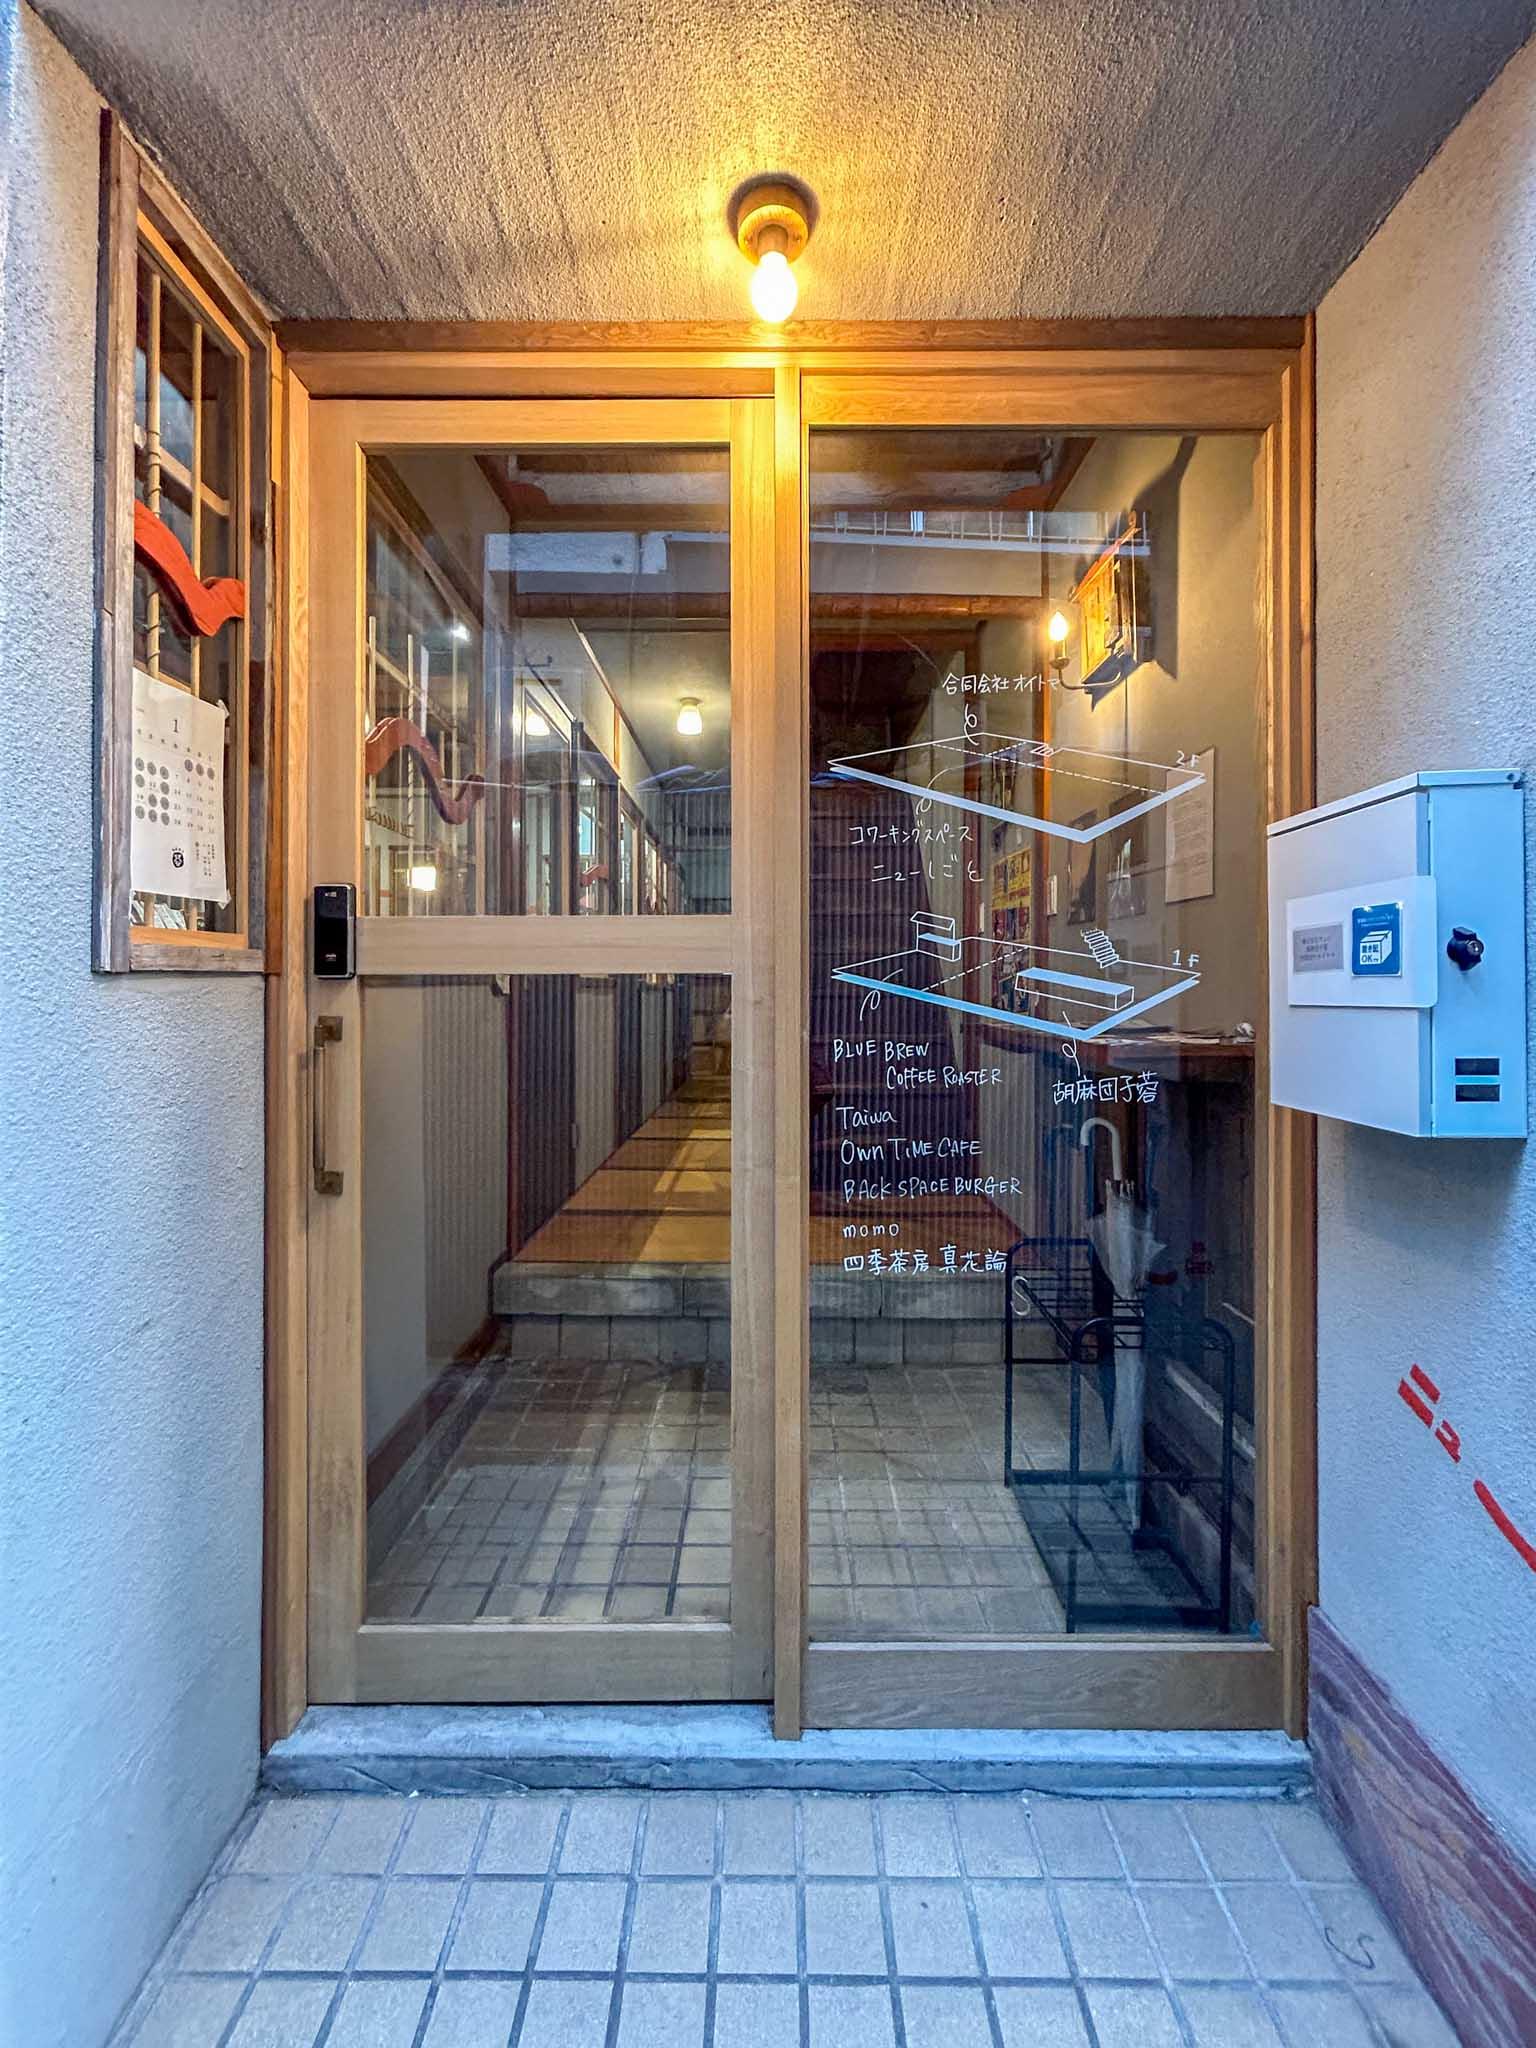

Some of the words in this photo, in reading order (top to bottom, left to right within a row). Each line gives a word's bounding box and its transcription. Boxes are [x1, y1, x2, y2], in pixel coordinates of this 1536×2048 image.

[849, 820, 974, 845] コワーキングスペース
[833, 1038, 877, 1063] BLUE
[884, 1041, 930, 1063] BREW
[886, 1065, 937, 1090] COFFEE
[942, 1066, 1003, 1089] ROASTER
[836, 1106, 898, 1130] Taiwa
[937, 1137, 983, 1158] CAFE
[897, 1177, 950, 1199] SPACE
[954, 1176, 1023, 1198] BURGER
[842, 1223, 900, 1239] momo
[843, 1248, 930, 1276] 四季茶房
[938, 1243, 1009, 1274] 真花論
